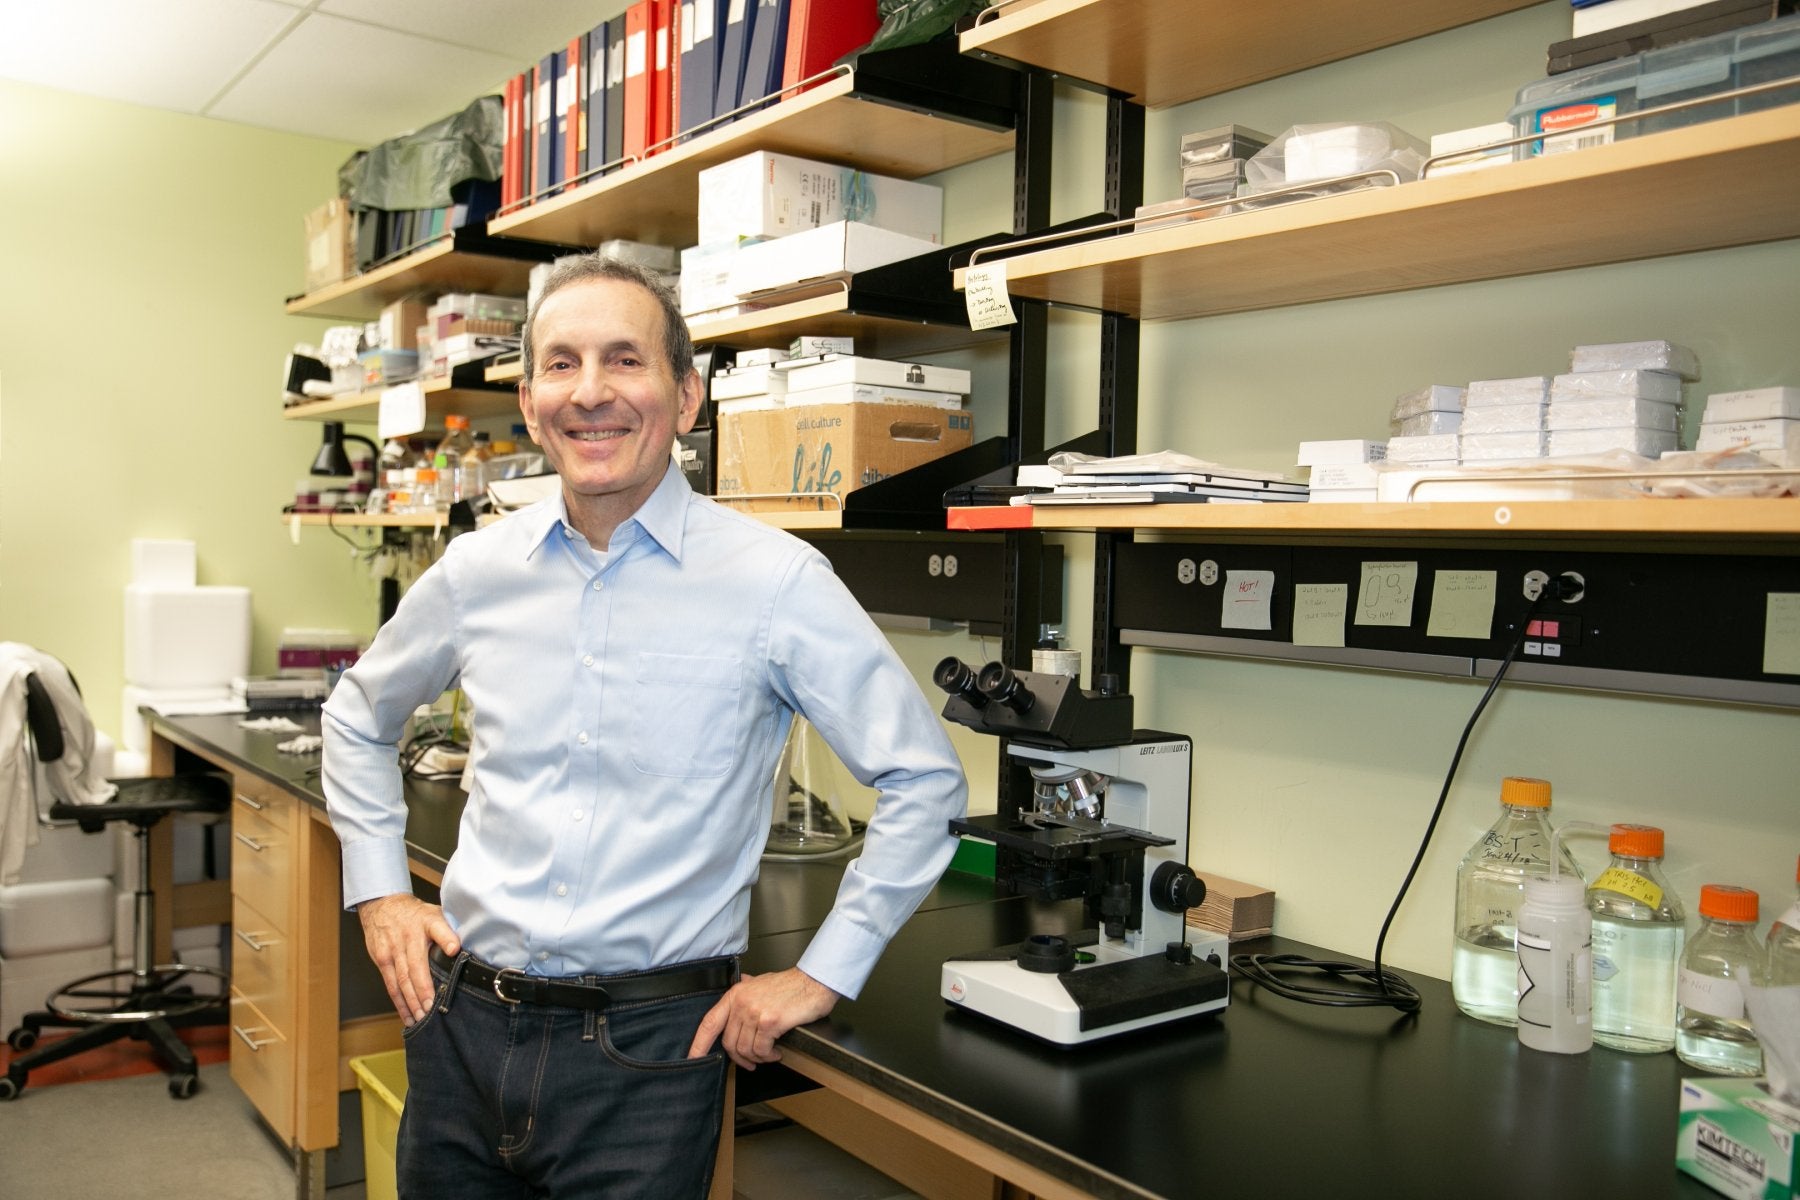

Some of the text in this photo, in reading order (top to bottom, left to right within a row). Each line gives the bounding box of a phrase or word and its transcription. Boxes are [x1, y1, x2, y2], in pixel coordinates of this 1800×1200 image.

[1543, 107, 1597, 125] Rubbermaid
[796, 415, 842, 431] cell culture
[787, 442, 842, 511] life
[1238, 580, 1260, 595] HOT!
[1140, 746, 1156, 755] LEITZ
[1697, 1125, 1764, 1172] KIMTECH
